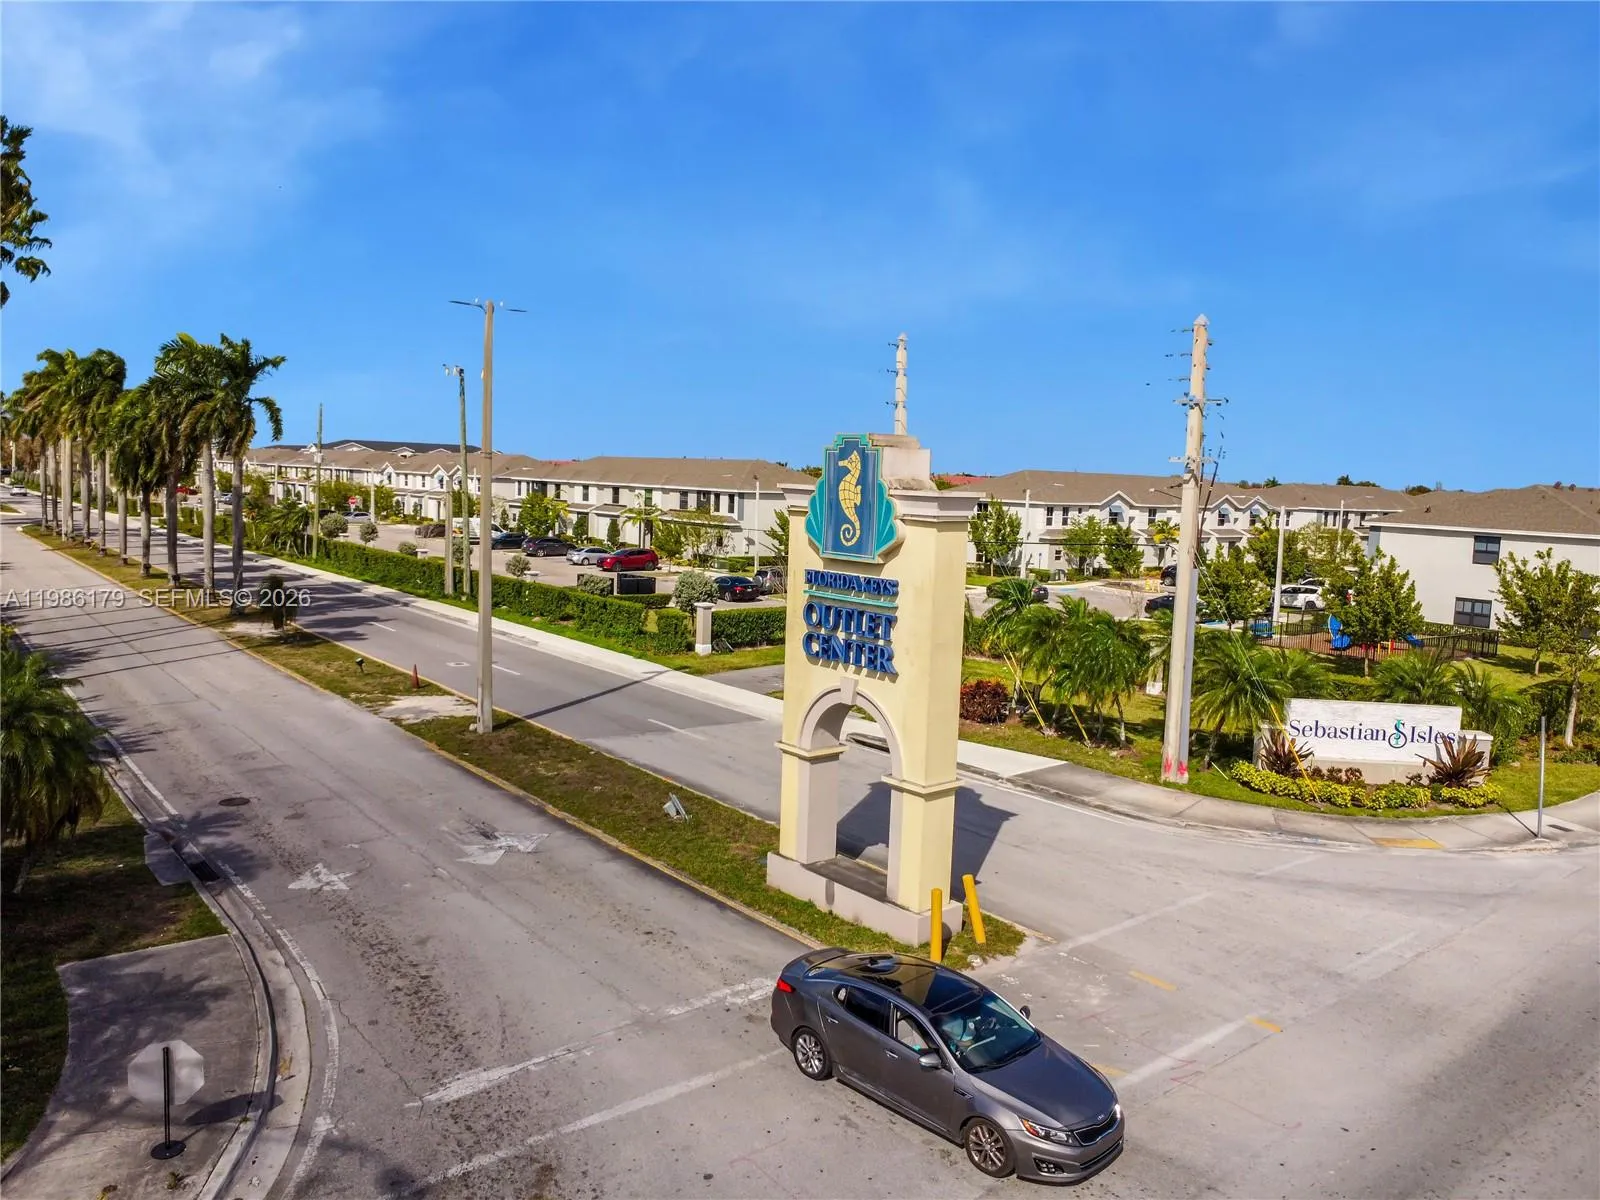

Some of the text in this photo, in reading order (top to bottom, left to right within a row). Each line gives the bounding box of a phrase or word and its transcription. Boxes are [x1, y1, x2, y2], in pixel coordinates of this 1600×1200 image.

[804, 569, 898, 596] FLORIDA KEYS
[803, 601, 897, 641] OUTLET
[802, 631, 897, 675] CENTER
[1288, 719, 1387, 741] Sebastian
[1410, 725, 1456, 745] Isles
